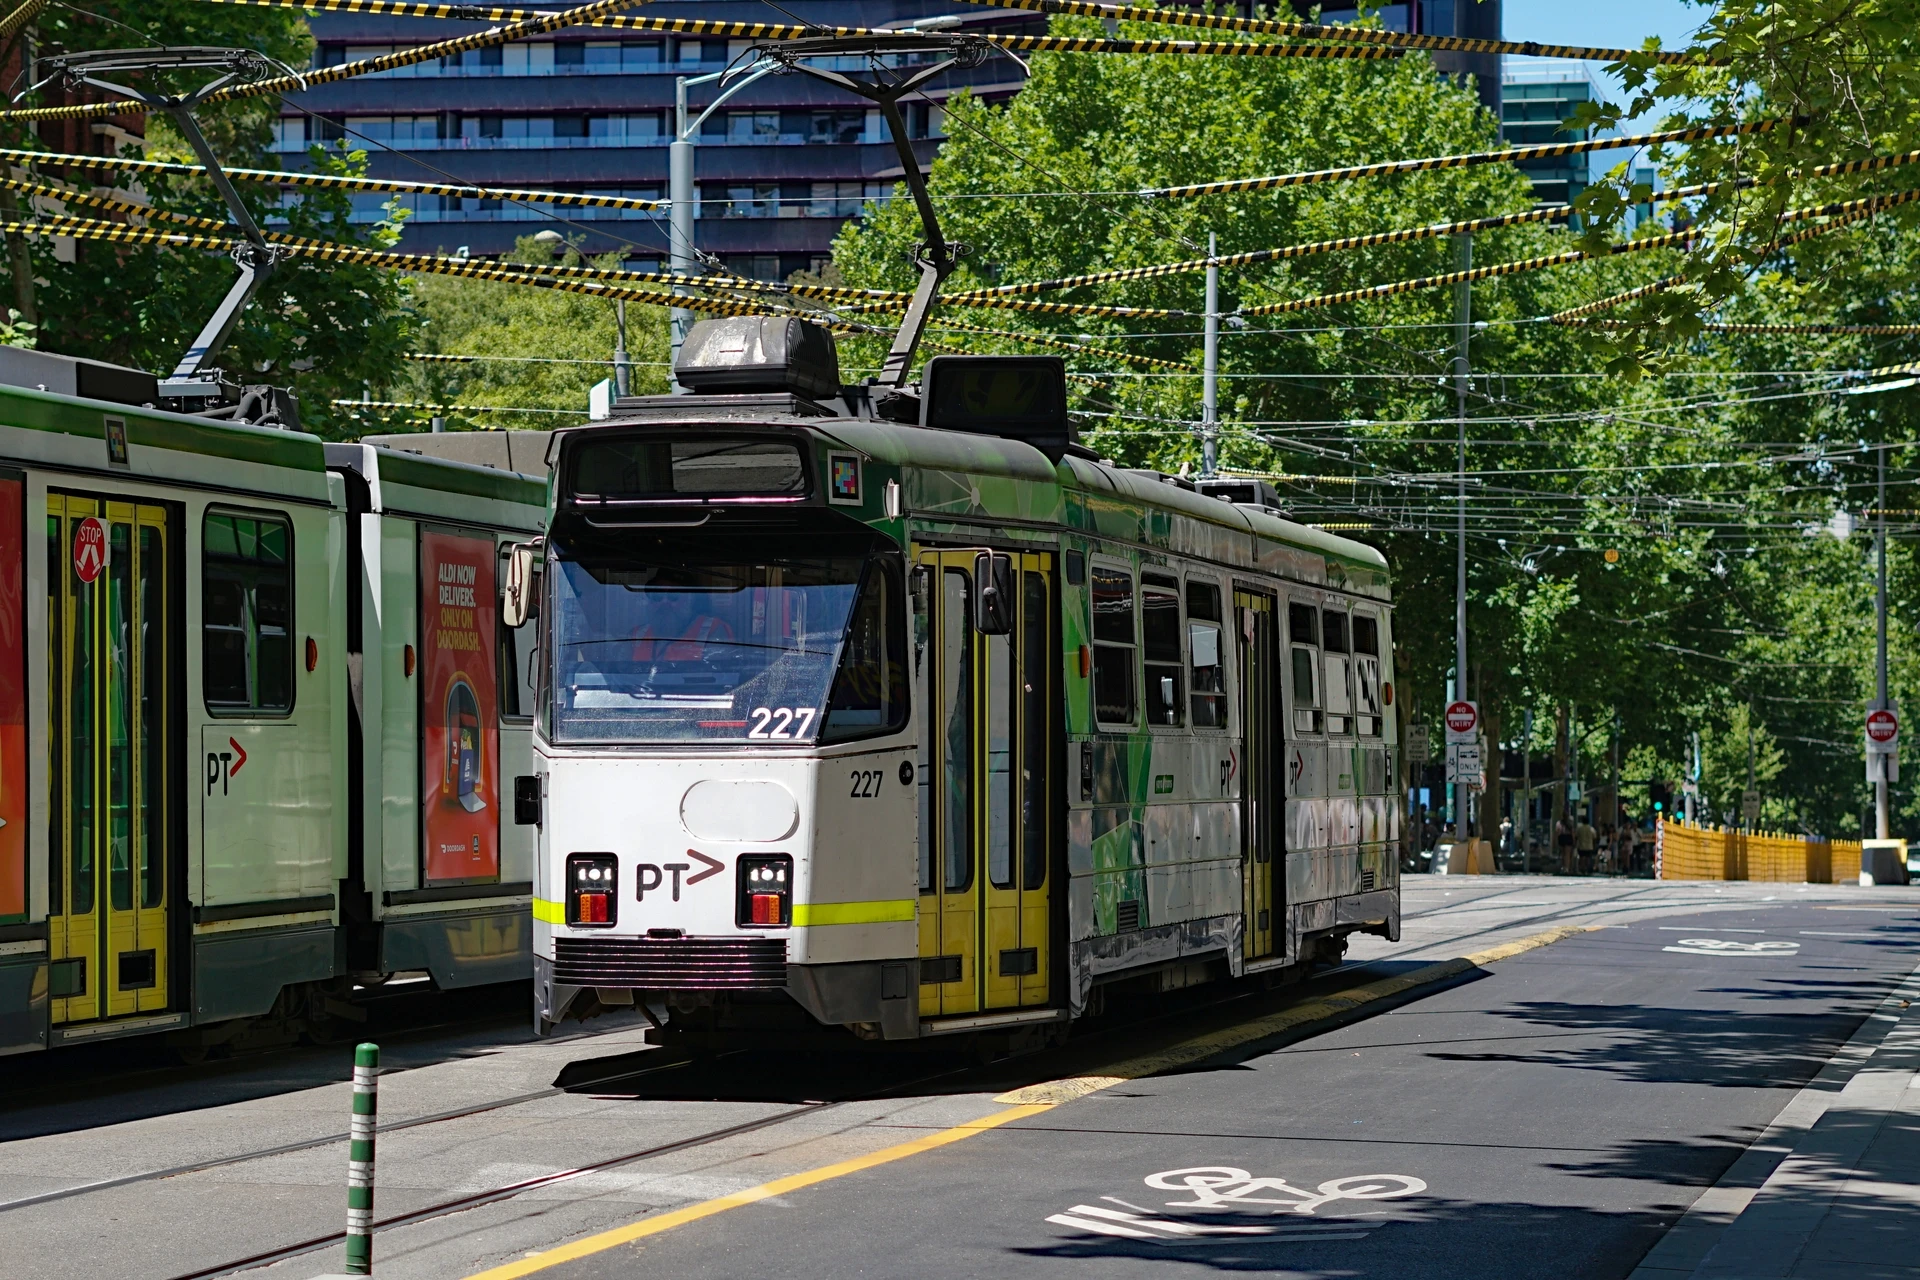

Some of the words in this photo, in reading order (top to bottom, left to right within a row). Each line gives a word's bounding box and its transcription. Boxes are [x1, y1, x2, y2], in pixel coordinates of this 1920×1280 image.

[80, 526, 101, 543] STOP
[438, 563, 456, 583] ALDI
[457, 565, 476, 585] NOW
[439, 585, 476, 607] DELIVERS.
[441, 607, 460, 628] ONLY
[461, 609, 473, 629] ON
[437, 629, 480, 651] DOORDASH.
[749, 707, 816, 739] 227
[850, 771, 883, 798] 227
